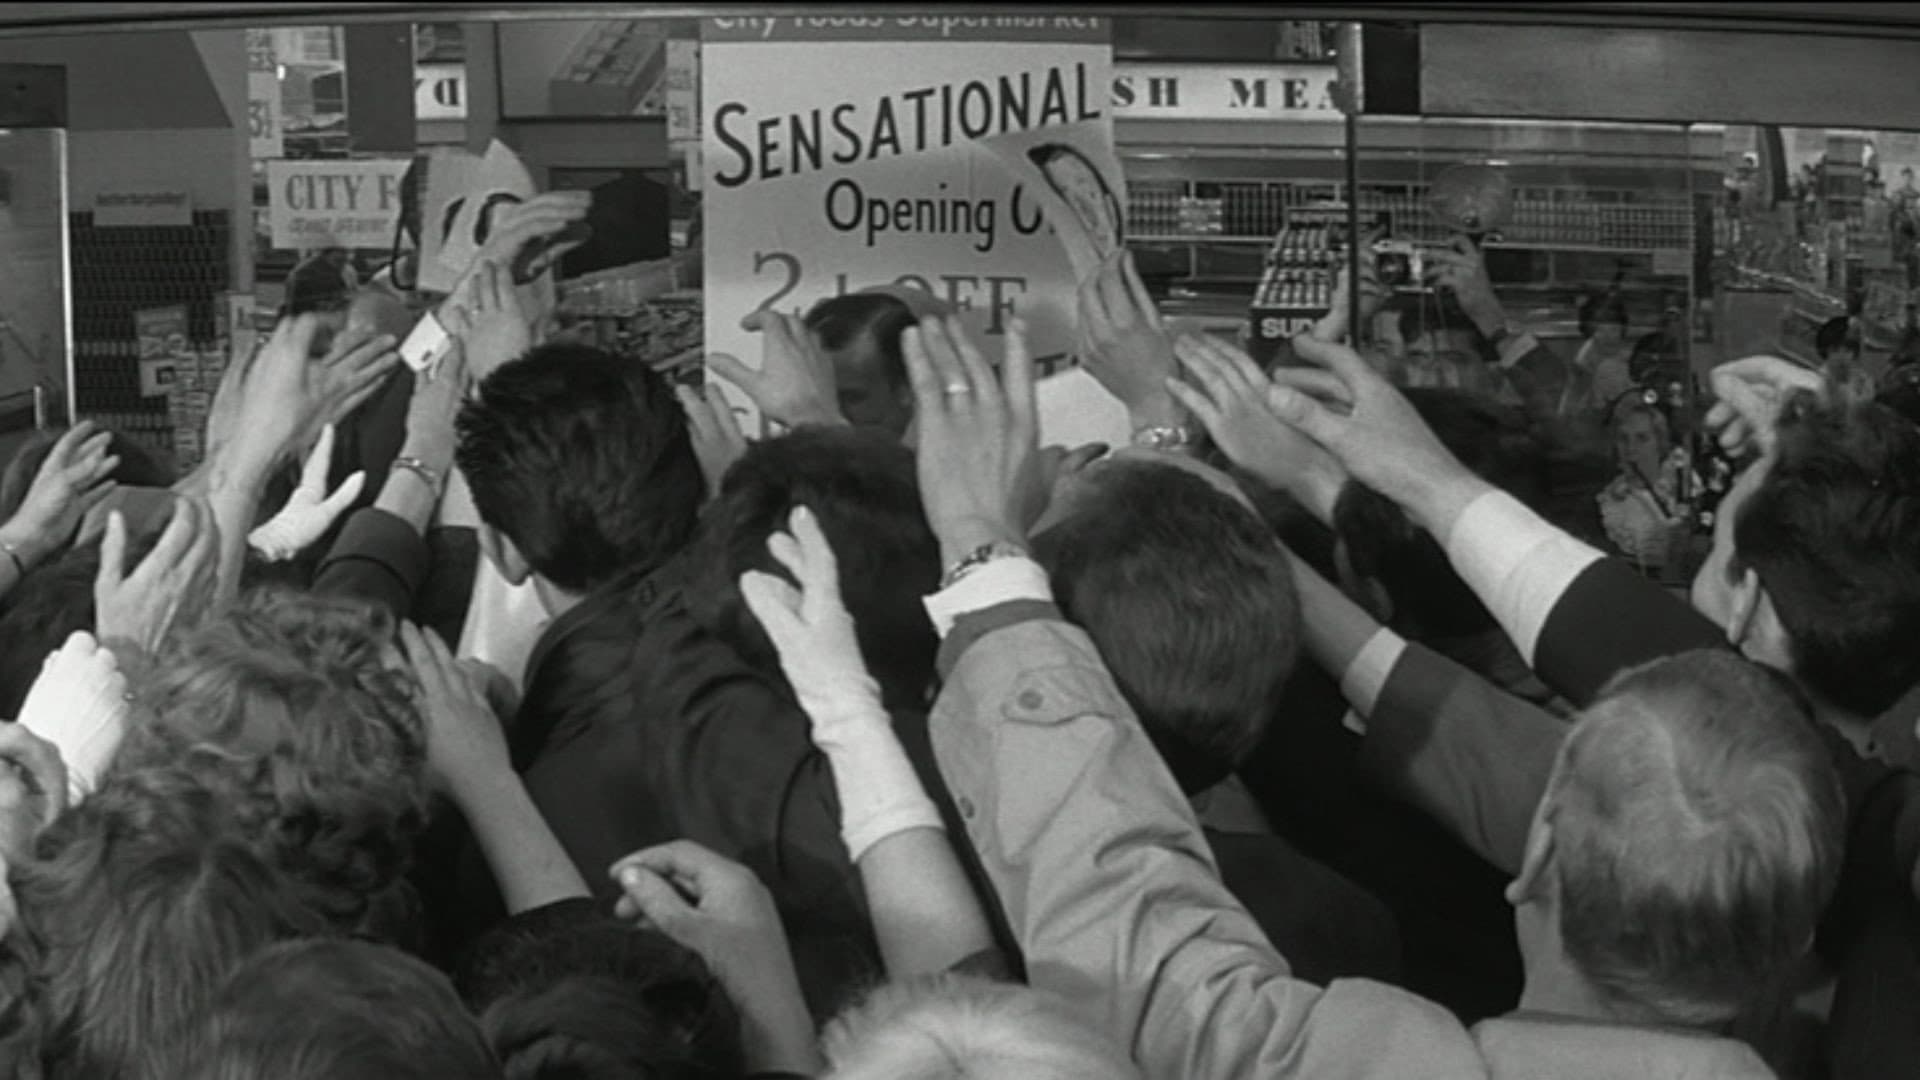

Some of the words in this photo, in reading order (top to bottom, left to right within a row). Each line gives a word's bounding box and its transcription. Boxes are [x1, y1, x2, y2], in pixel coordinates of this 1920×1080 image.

[714, 62, 1100, 188] SENSATIONAL
[285, 174, 363, 210] CITY
[825, 178, 996, 253] Opening
